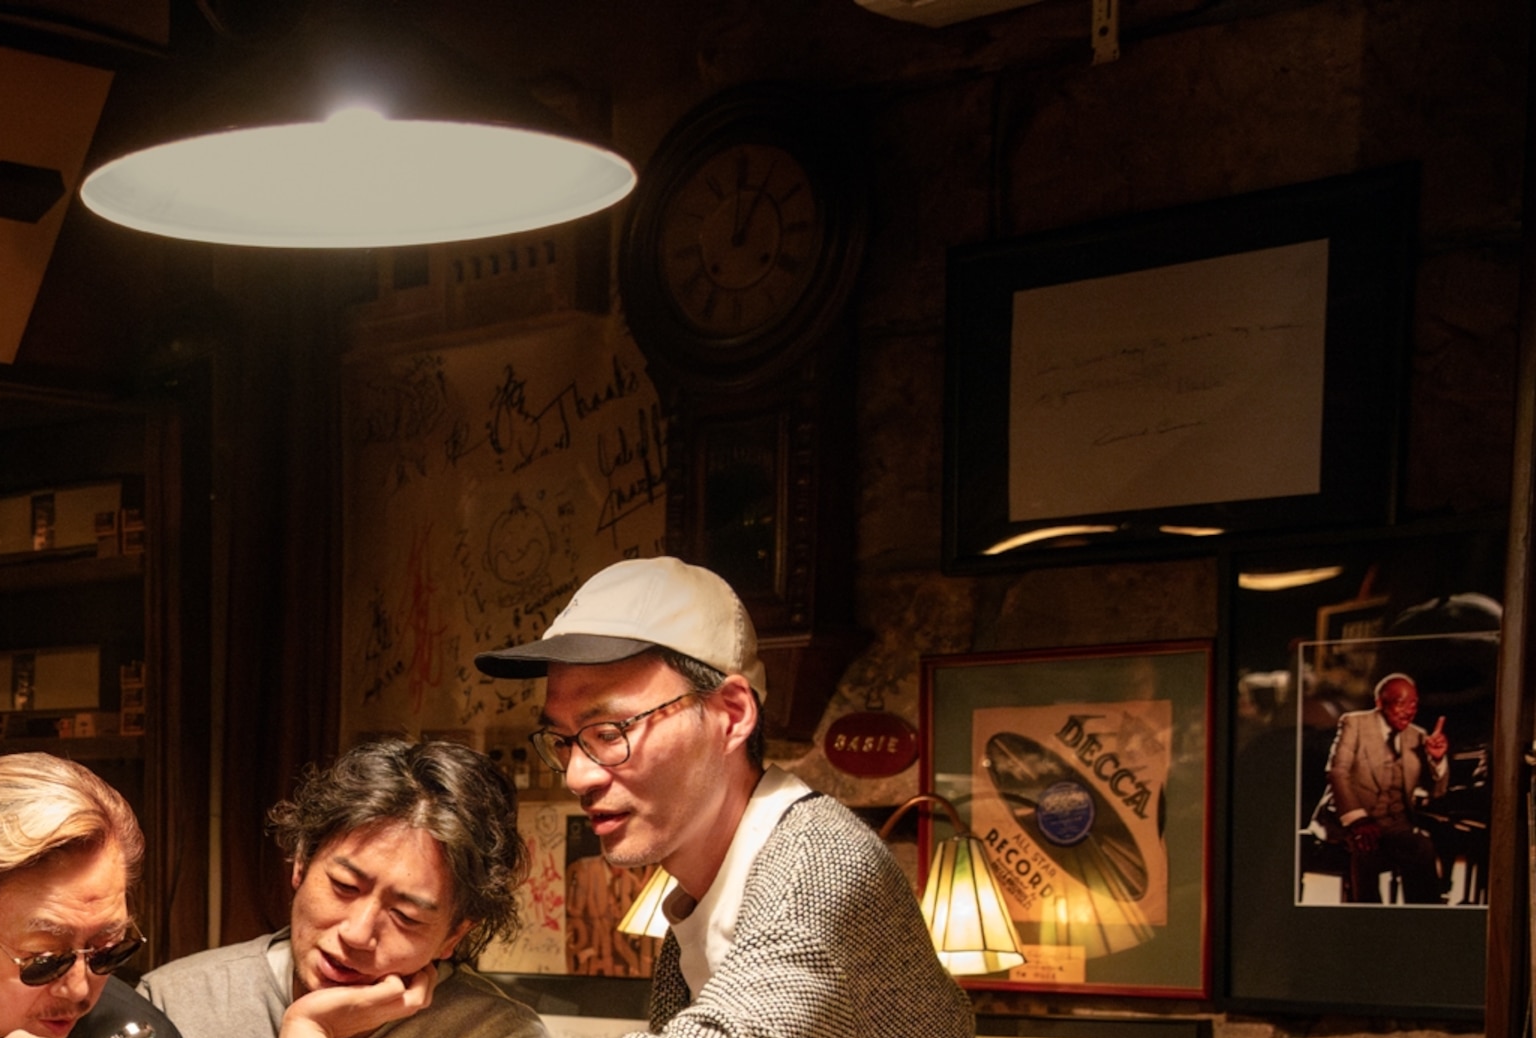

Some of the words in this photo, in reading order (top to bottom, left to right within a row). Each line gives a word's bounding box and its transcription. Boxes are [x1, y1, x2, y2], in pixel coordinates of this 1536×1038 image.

[834, 733, 899, 754] BASIE
[1054, 714, 1150, 820] DECCA
[985, 827, 1064, 904] RECORD
[1012, 833, 1031, 854] ALL
[1031, 852, 1057, 878] STAR
